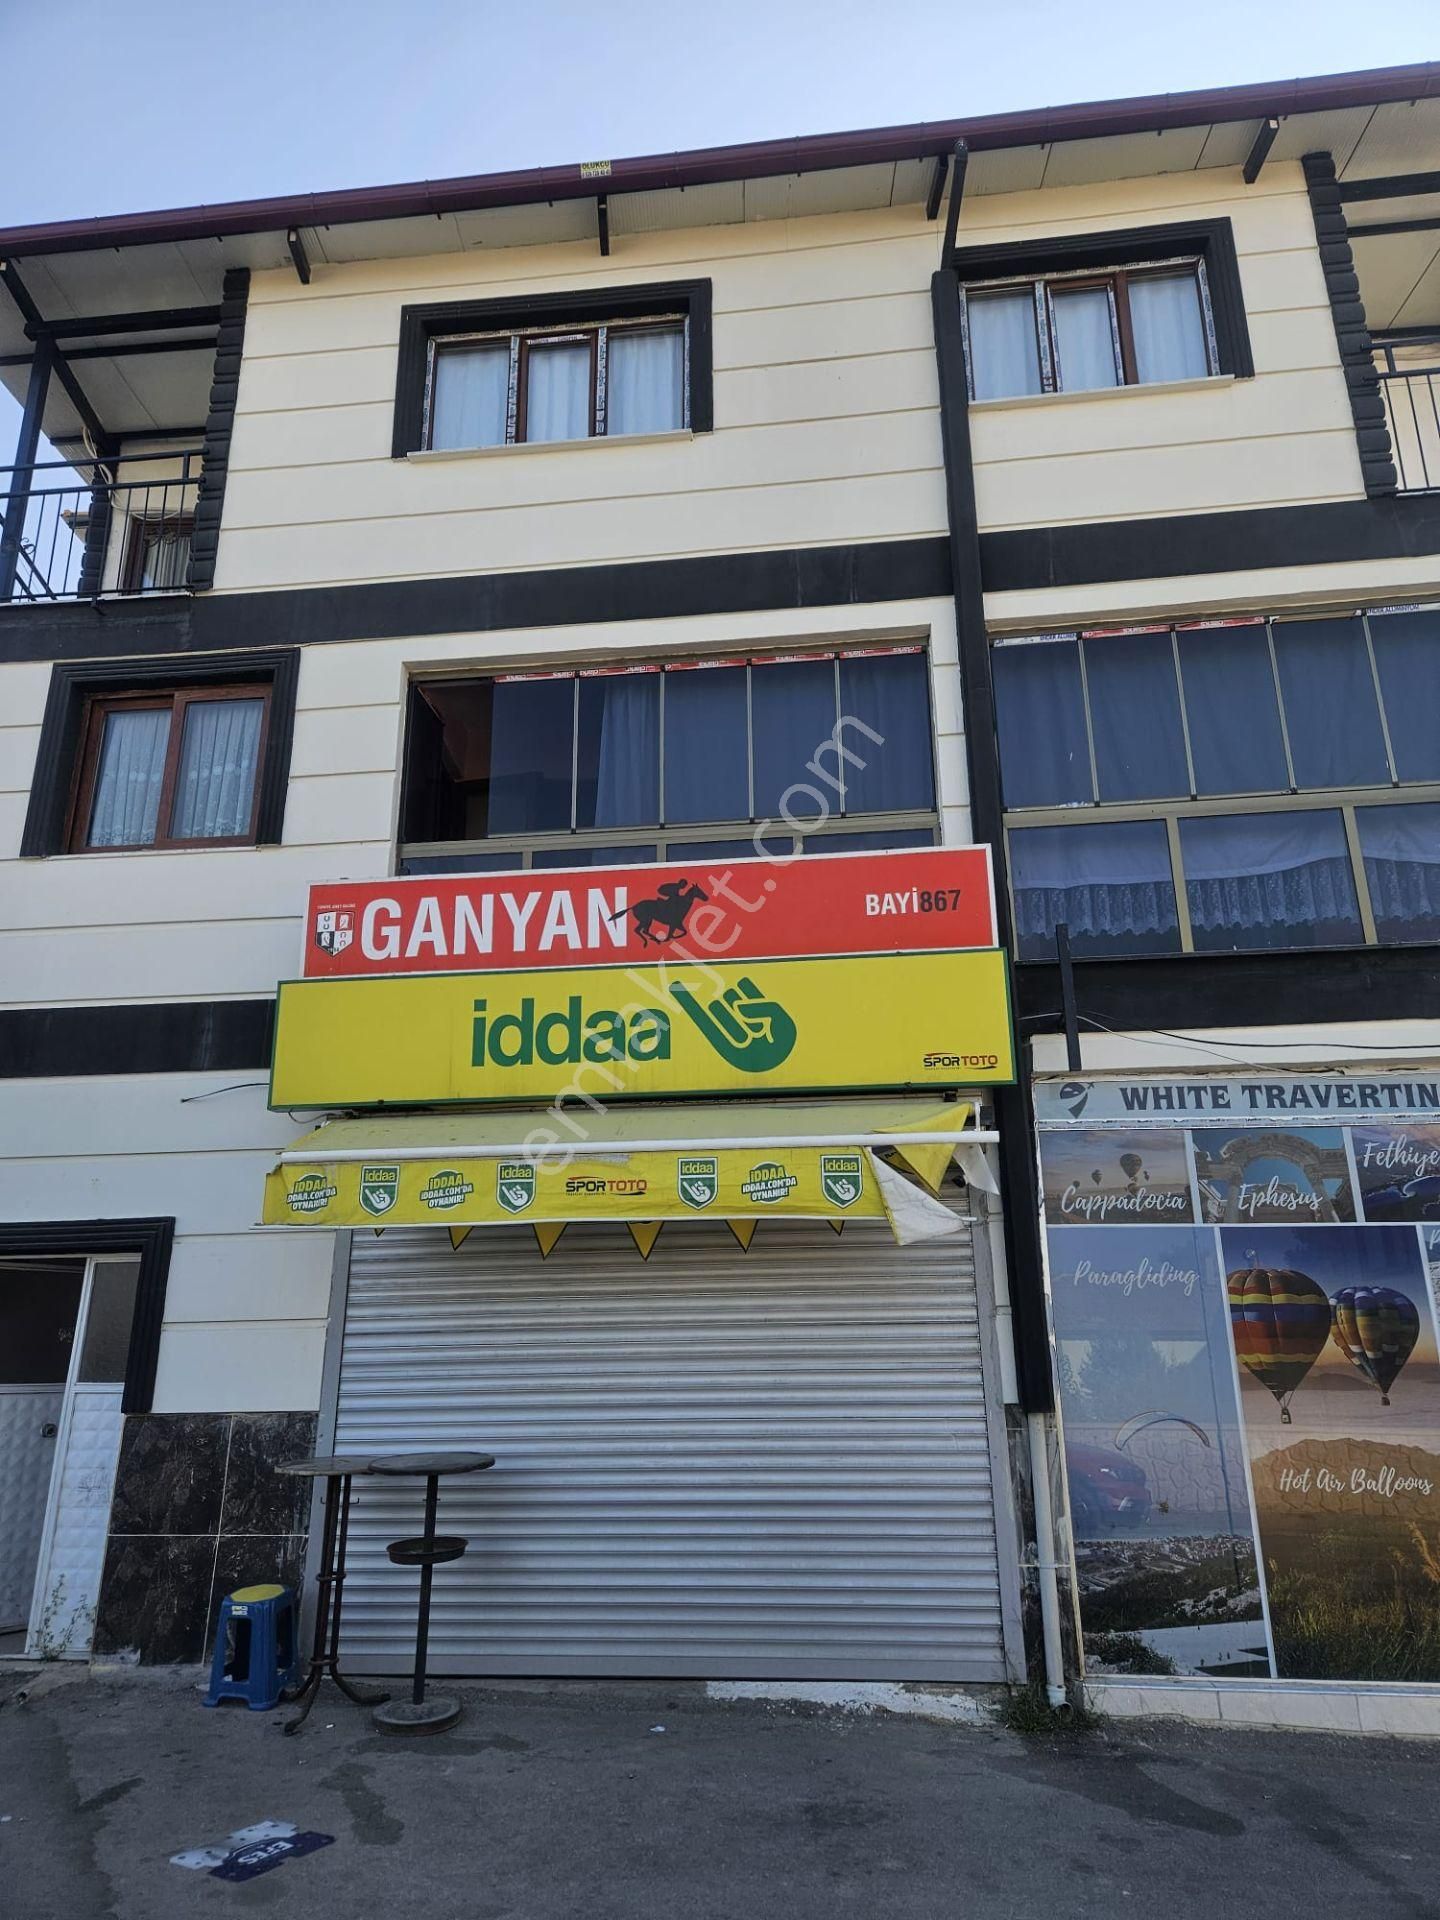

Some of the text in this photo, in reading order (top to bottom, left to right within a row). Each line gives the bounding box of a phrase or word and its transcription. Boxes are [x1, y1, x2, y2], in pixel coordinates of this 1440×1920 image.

[361, 887, 627, 960] GANYAN
[472, 995, 671, 1068] iddaa
[1120, 1085, 1231, 1111] WHITE
[365, 1171, 396, 1182] iddaa
[502, 1167, 532, 1178] iddaa
[682, 1163, 713, 1174] iddaa
[825, 1160, 857, 1171] iddaa
[1061, 1185, 1187, 1220] Cappadocia
[1238, 1176, 1323, 1217] Ephesus
[1074, 1257, 1200, 1296] Paragliding
[1280, 1466, 1434, 1498] Hot Air Balloons
